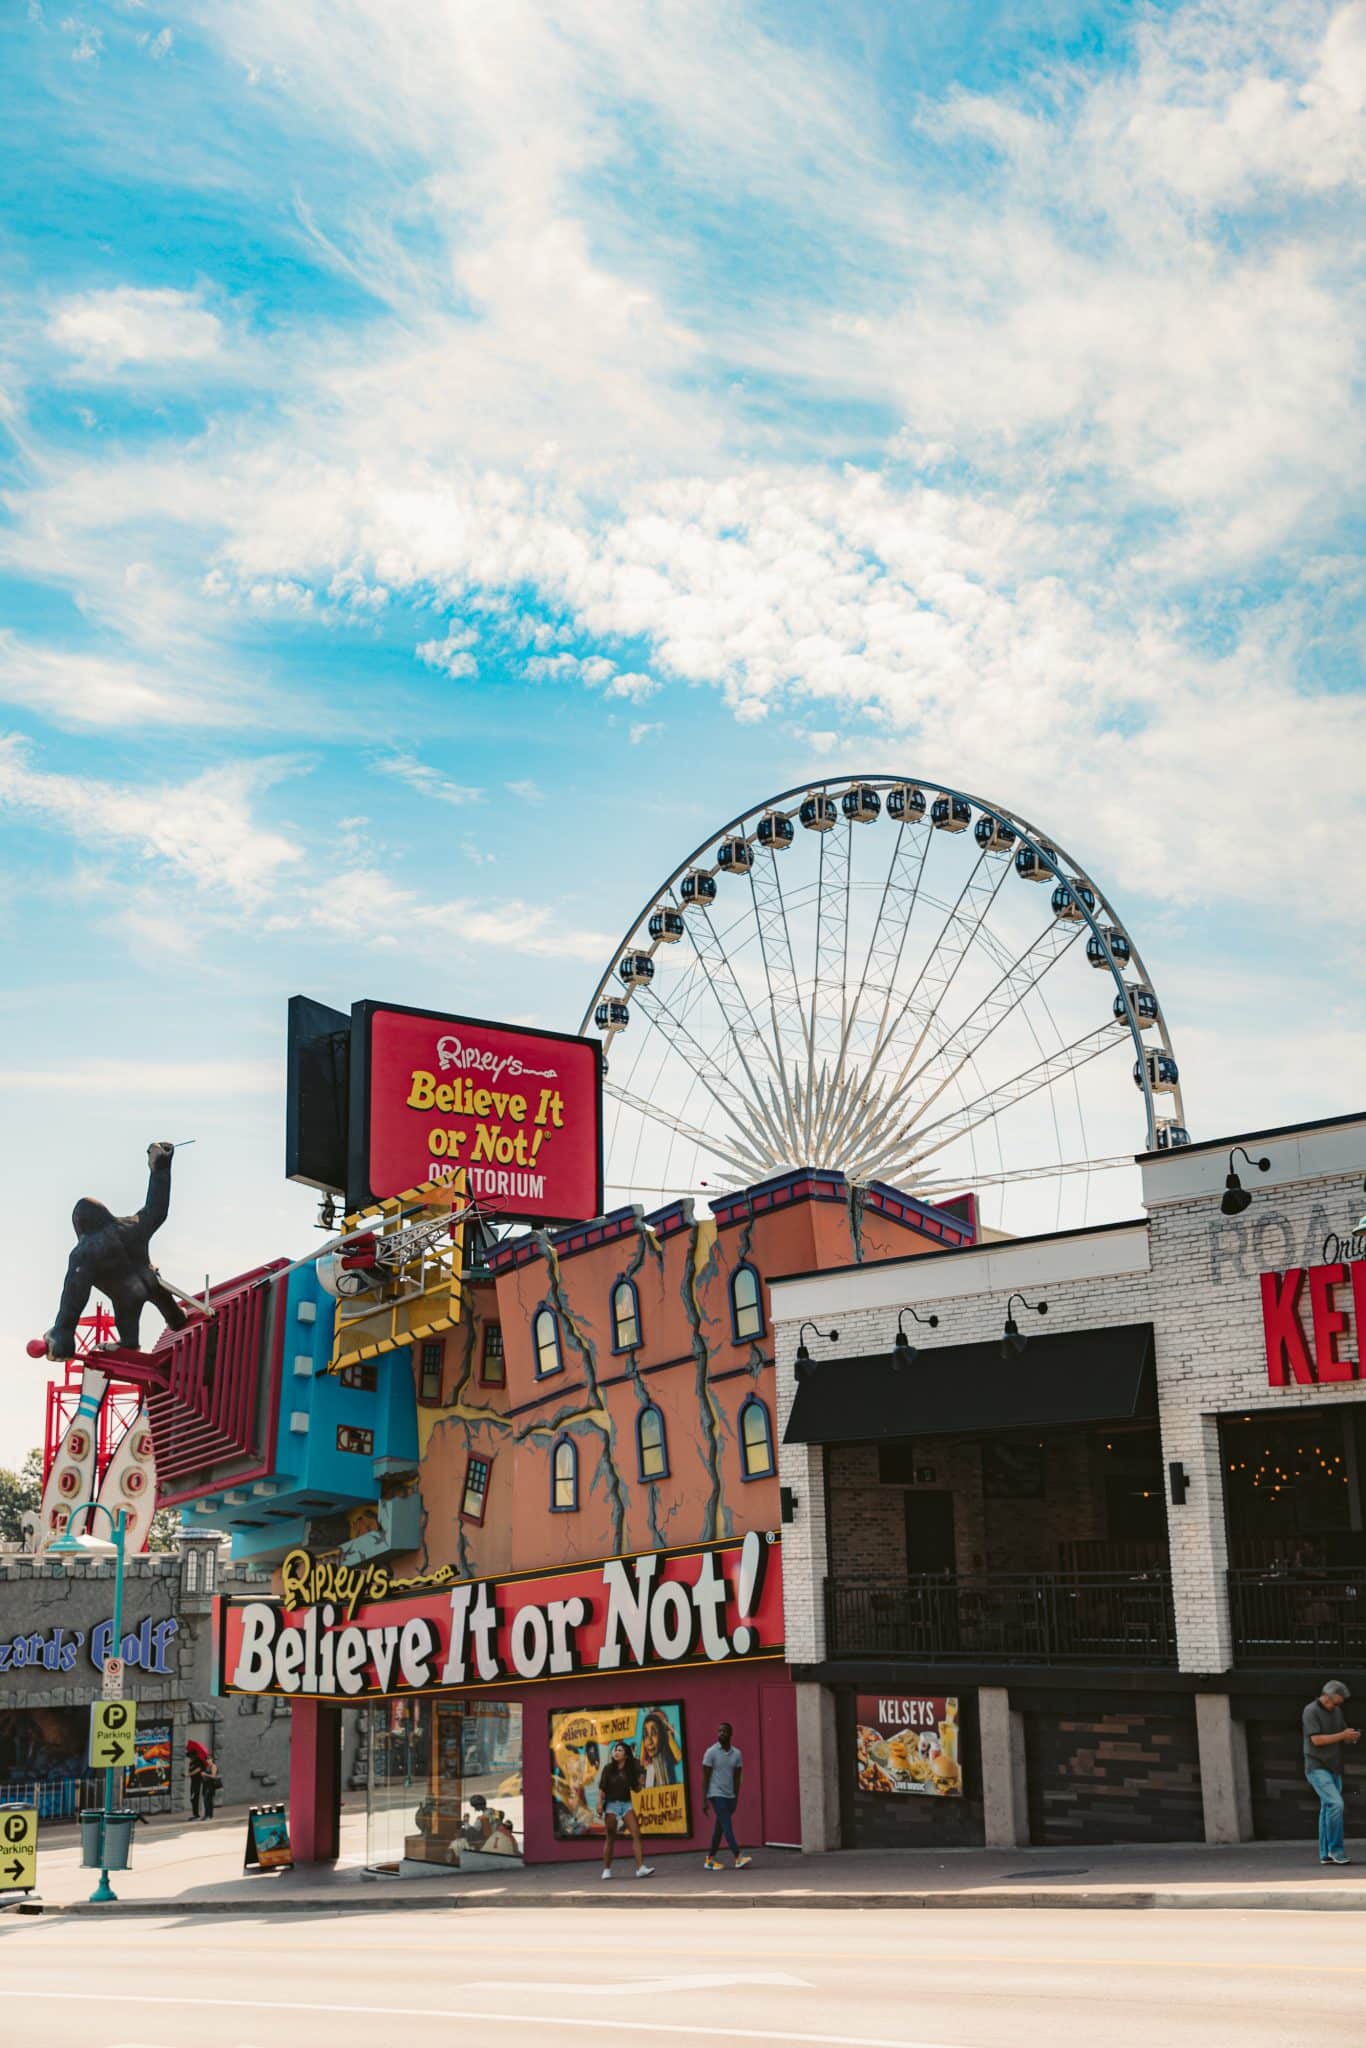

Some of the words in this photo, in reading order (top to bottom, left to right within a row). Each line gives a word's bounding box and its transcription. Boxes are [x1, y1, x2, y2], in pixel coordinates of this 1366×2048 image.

[407, 1071, 527, 1123] Believe
[534, 1089, 566, 1128] It
[428, 1127, 467, 1157] or
[428, 1162, 544, 1200] ODITORIUM
[234, 1603, 433, 1694] Believe
[441, 1583, 499, 1686] It
[510, 1596, 584, 1679] or
[597, 1531, 761, 1669] Not!
[90, 1616, 178, 1674] Golf
[879, 1699, 934, 1726] KELSEYS
[97, 1731, 131, 1741] Parking
[640, 1794, 655, 1811] ALL
[658, 1790, 678, 1808] NEW
